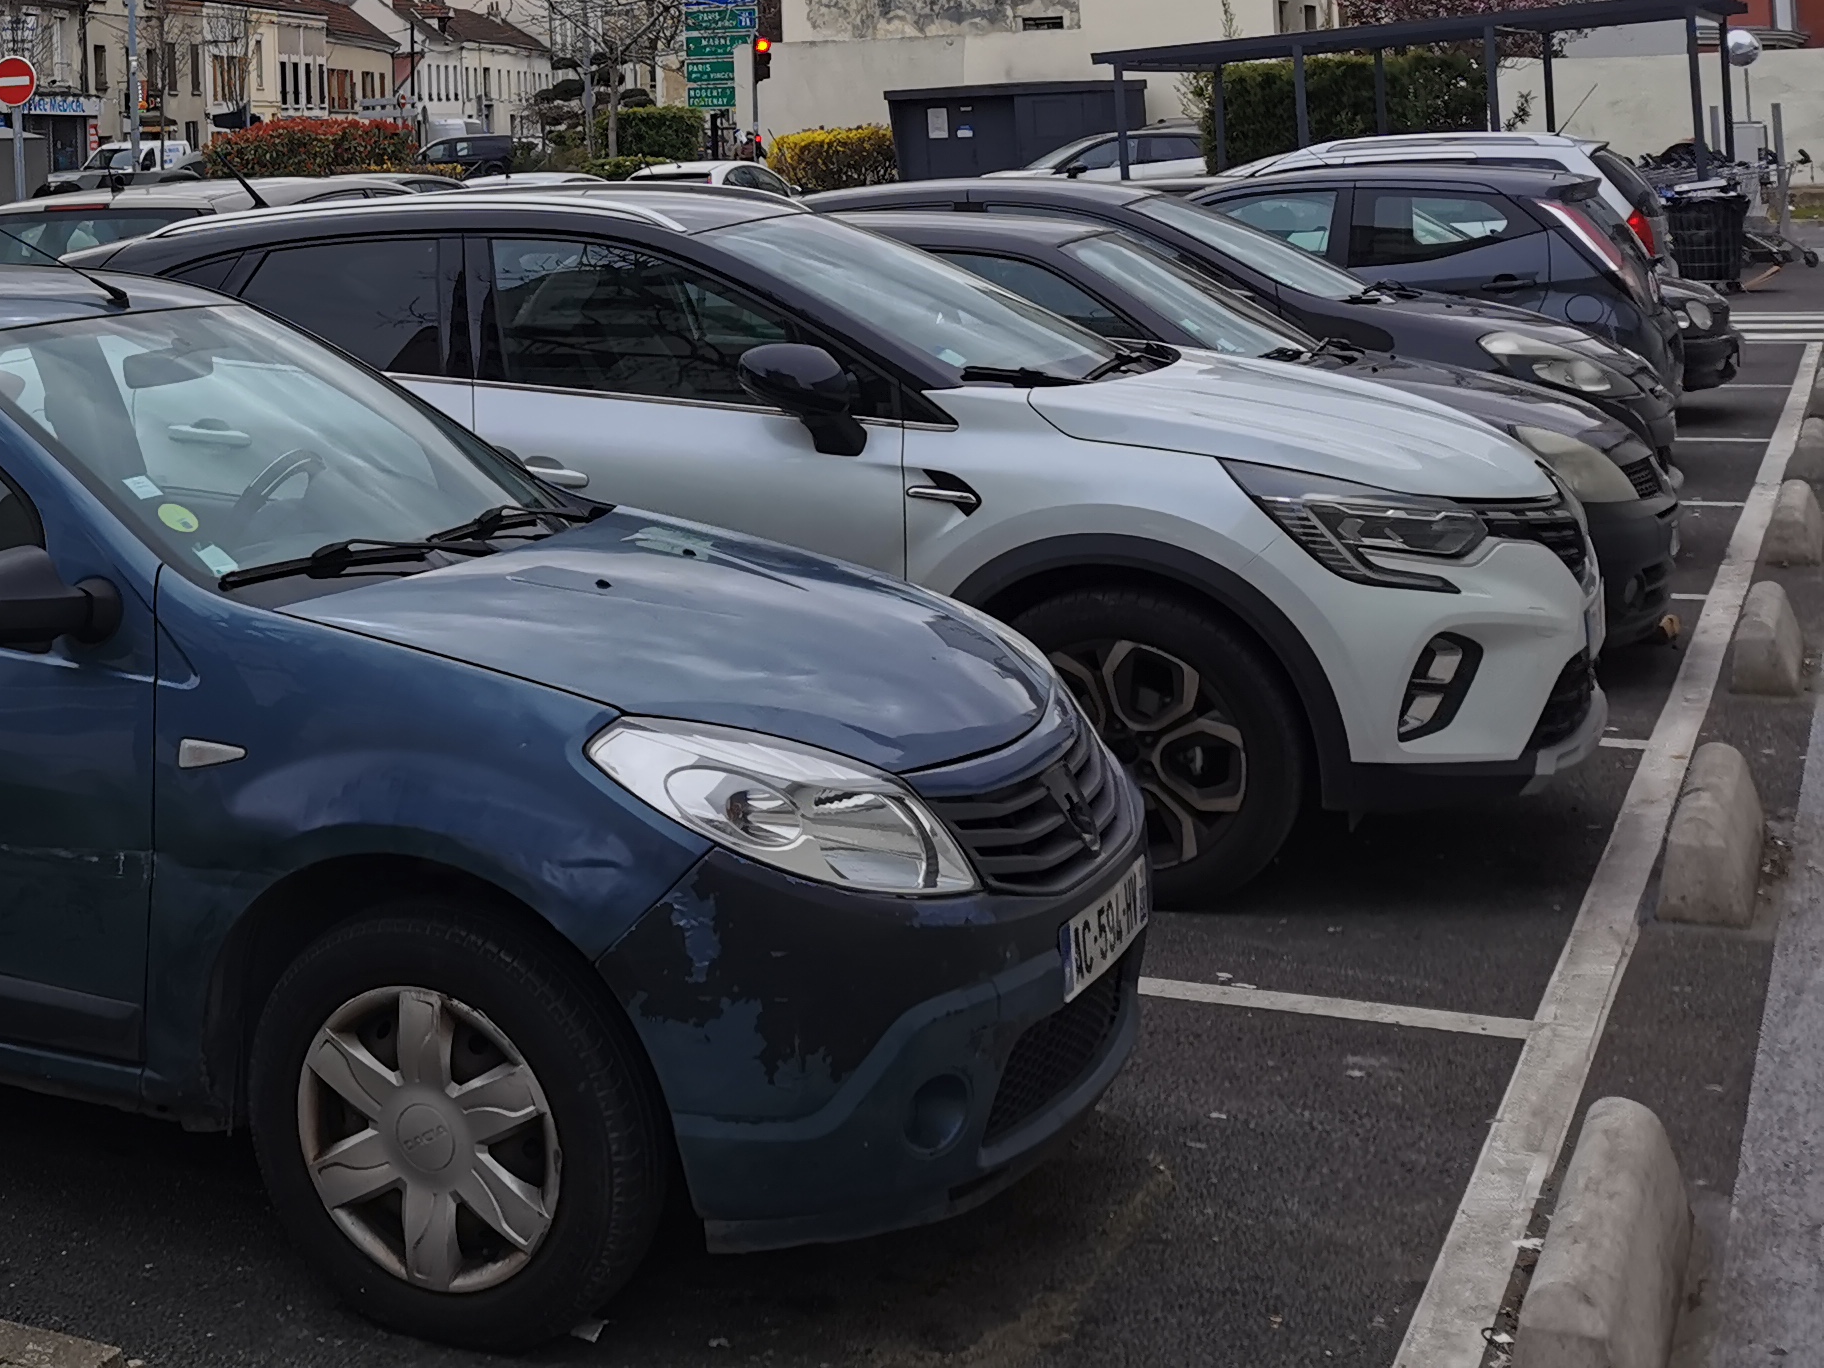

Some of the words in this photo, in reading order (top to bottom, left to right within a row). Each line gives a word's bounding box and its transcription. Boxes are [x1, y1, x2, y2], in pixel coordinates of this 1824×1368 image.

[688, 64, 711, 72] PARIS
[709, 72, 734, 80] VINCEN
[689, 88, 723, 97] NOGENT
